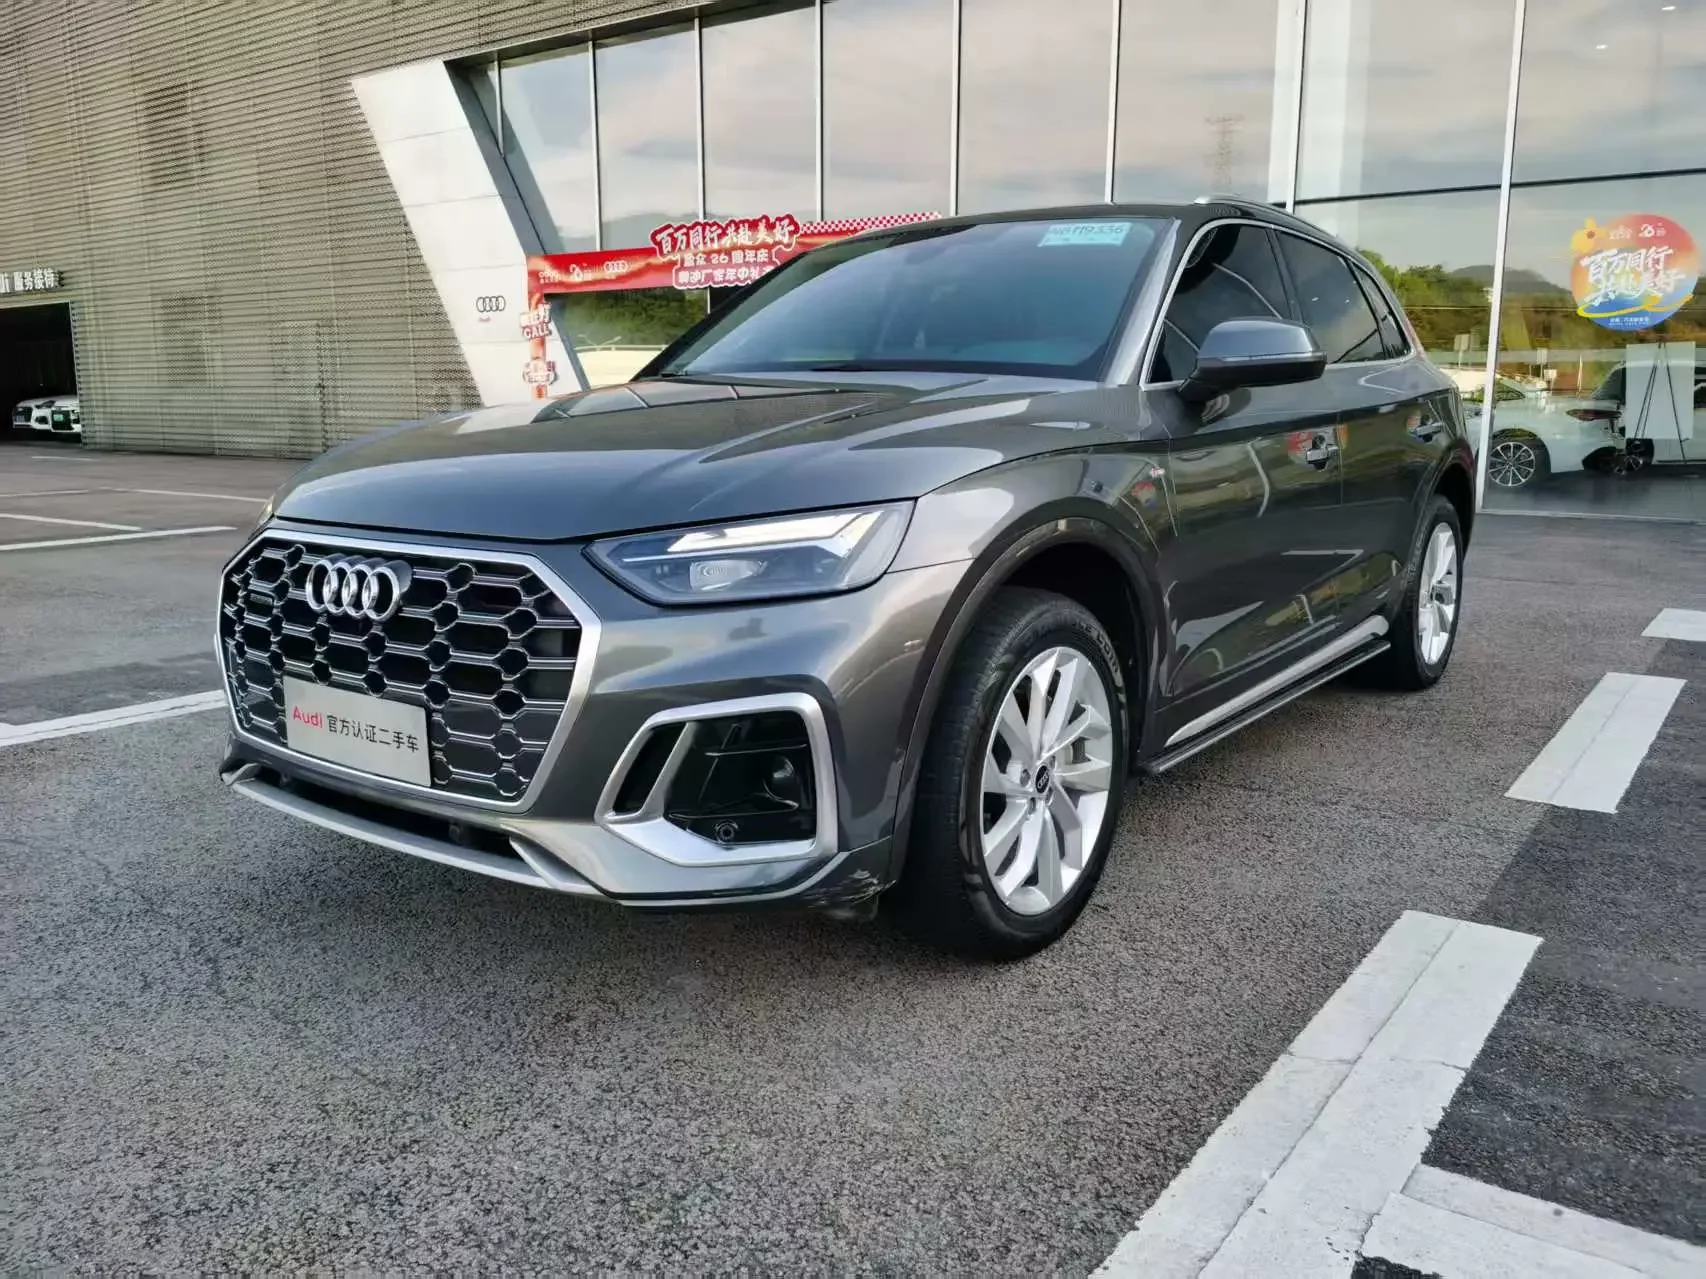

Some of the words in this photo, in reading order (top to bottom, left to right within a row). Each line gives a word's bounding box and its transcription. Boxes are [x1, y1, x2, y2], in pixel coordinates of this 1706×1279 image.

[293, 706, 323, 728] Audi
[327, 714, 419, 753] 官方认证二手车
